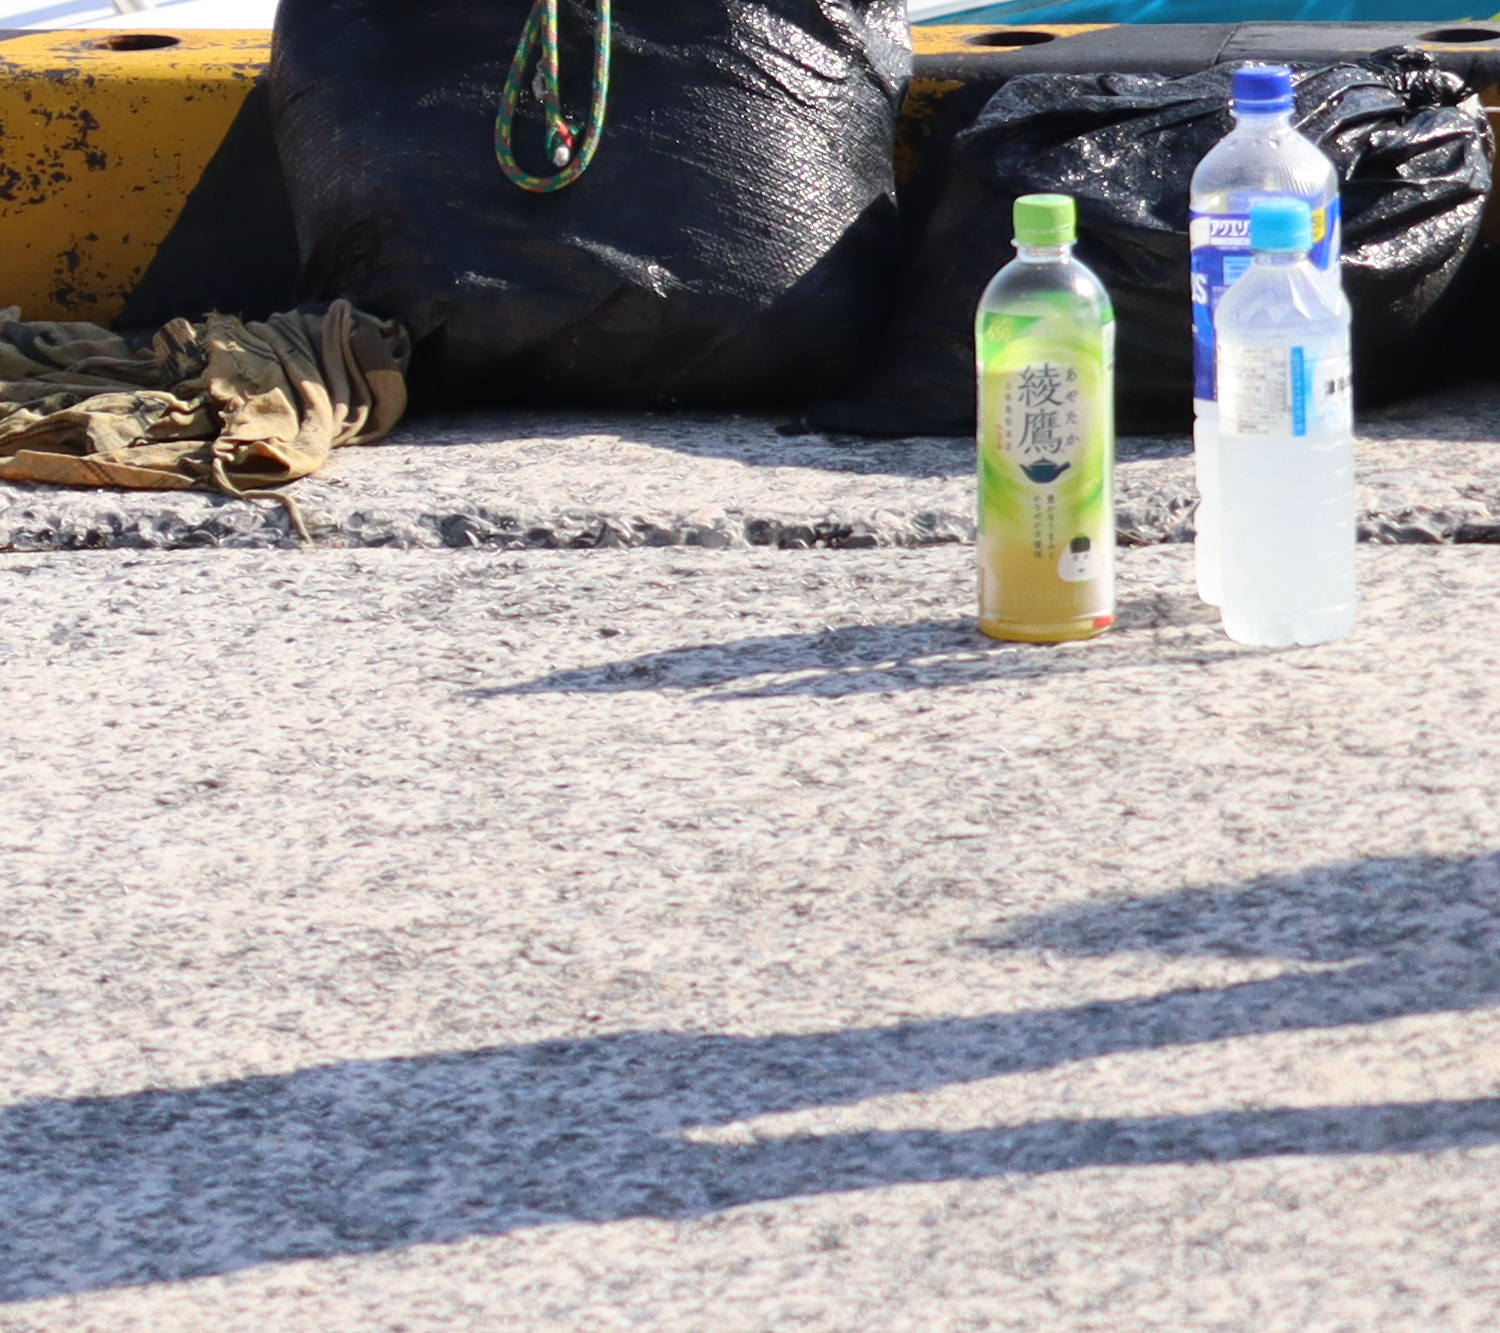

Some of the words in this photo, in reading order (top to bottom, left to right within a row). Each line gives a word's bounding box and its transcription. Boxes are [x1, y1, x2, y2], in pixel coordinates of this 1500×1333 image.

[1210, 219, 1250, 236] アクエリ
[987, 326, 1011, 342] 650
[1018, 362, 1063, 454] 綾鷹
[1065, 367, 1080, 446] あやたか
